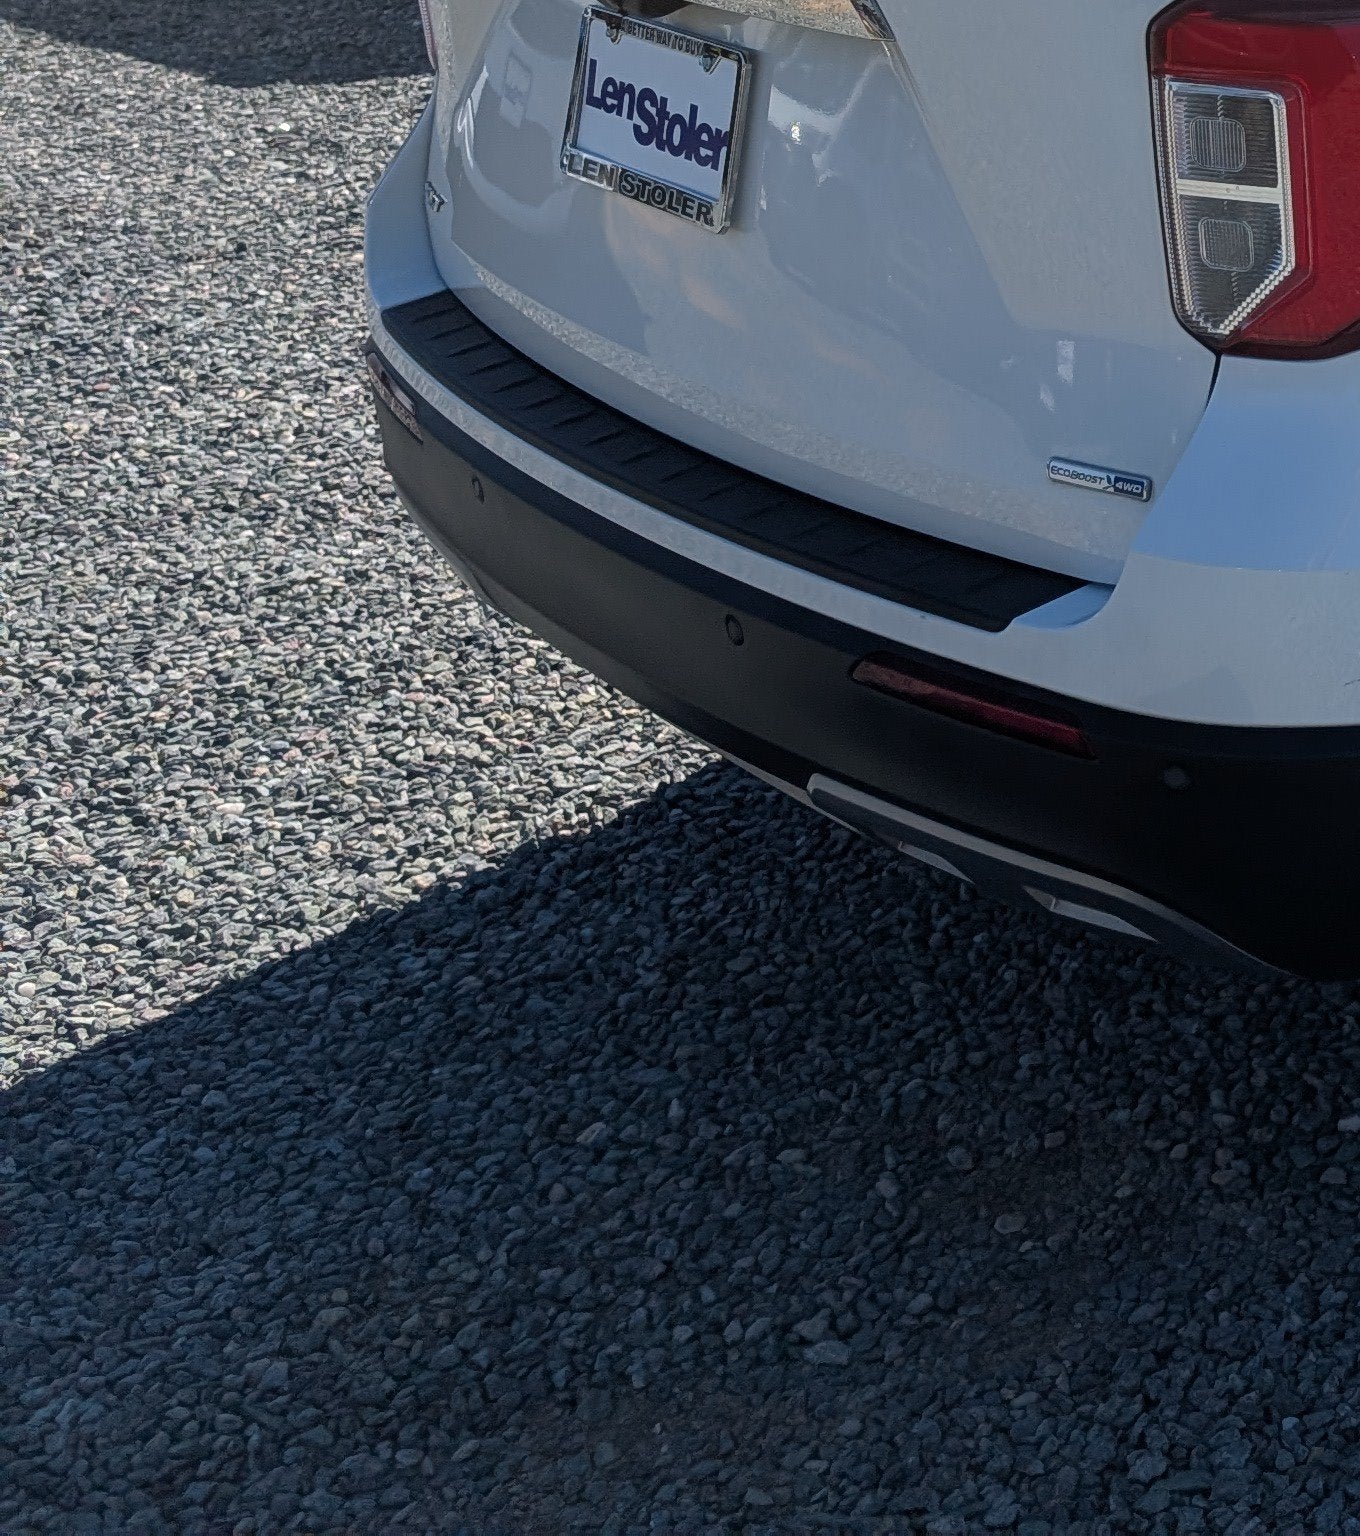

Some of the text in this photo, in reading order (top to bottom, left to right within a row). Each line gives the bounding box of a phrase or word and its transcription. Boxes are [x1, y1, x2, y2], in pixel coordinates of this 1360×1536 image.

[628, 22, 657, 42] BETTER
[657, 29, 673, 47] WAY
[673, 35, 685, 51] TO
[685, 38, 703, 56] BUY
[567, 159, 715, 228] LEN STOLER
[1116, 481, 1143, 493] 4WD
